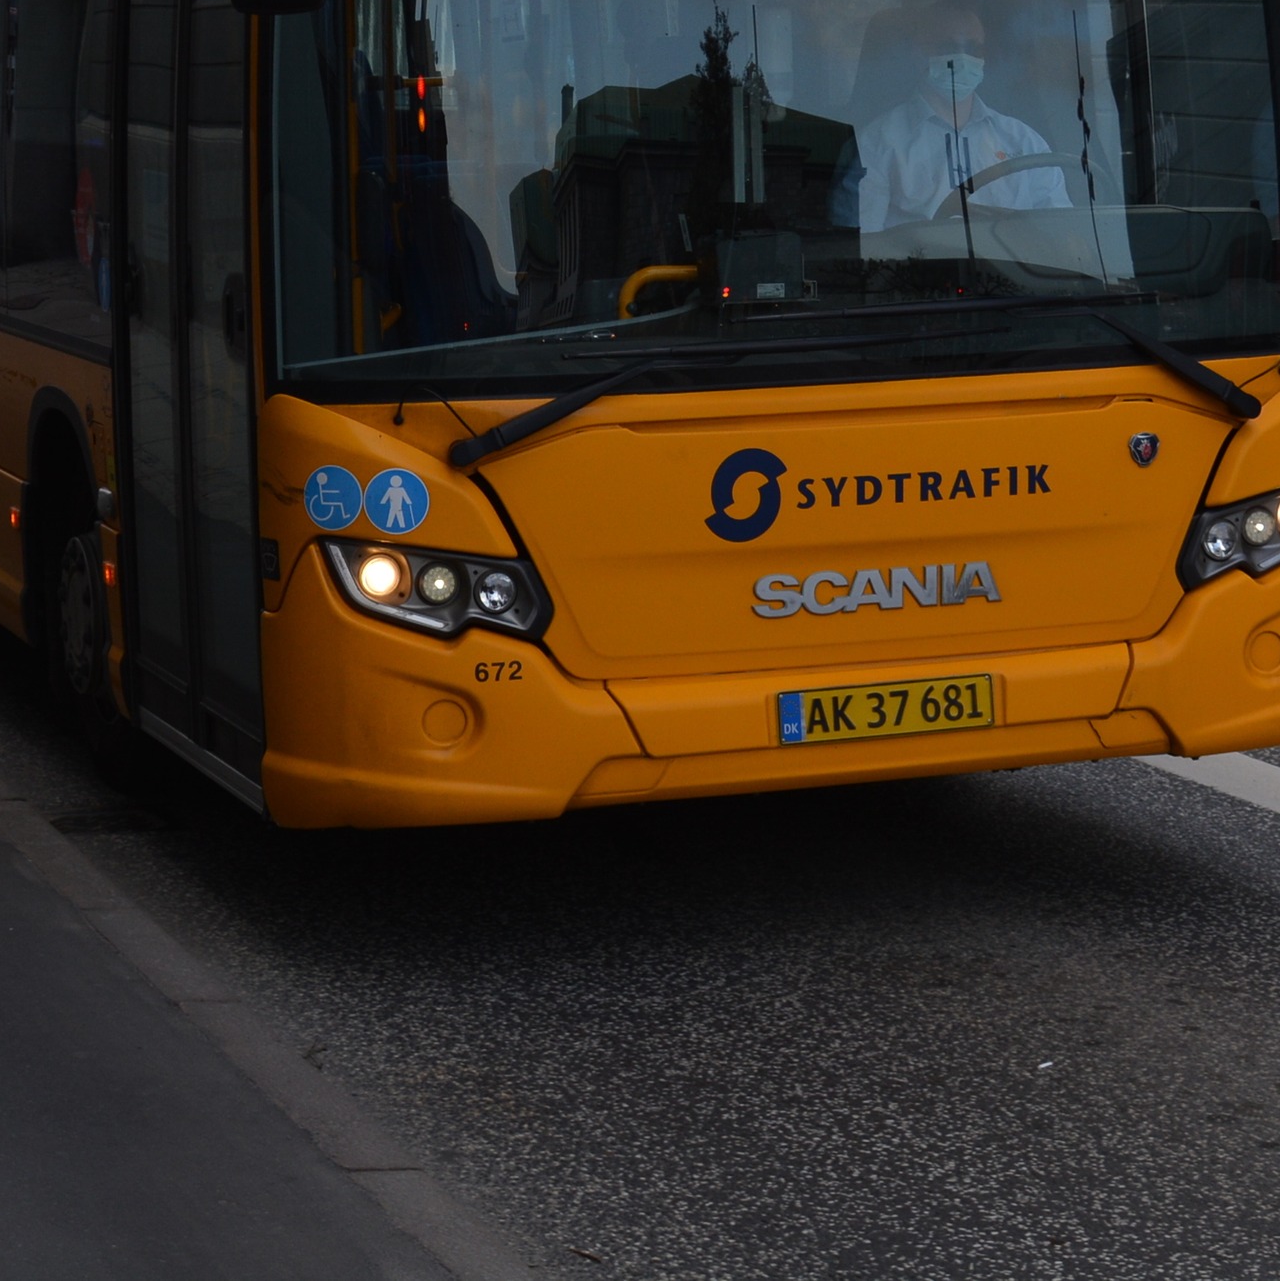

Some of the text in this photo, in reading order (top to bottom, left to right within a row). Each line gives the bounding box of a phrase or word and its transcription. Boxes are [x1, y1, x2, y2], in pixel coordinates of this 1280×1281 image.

[797, 464, 1052, 510] SYDTRAFIK
[751, 560, 1002, 619] SCANIA
[474, 660, 523, 683] 672
[784, 682, 984, 735] DK AK 37 681
